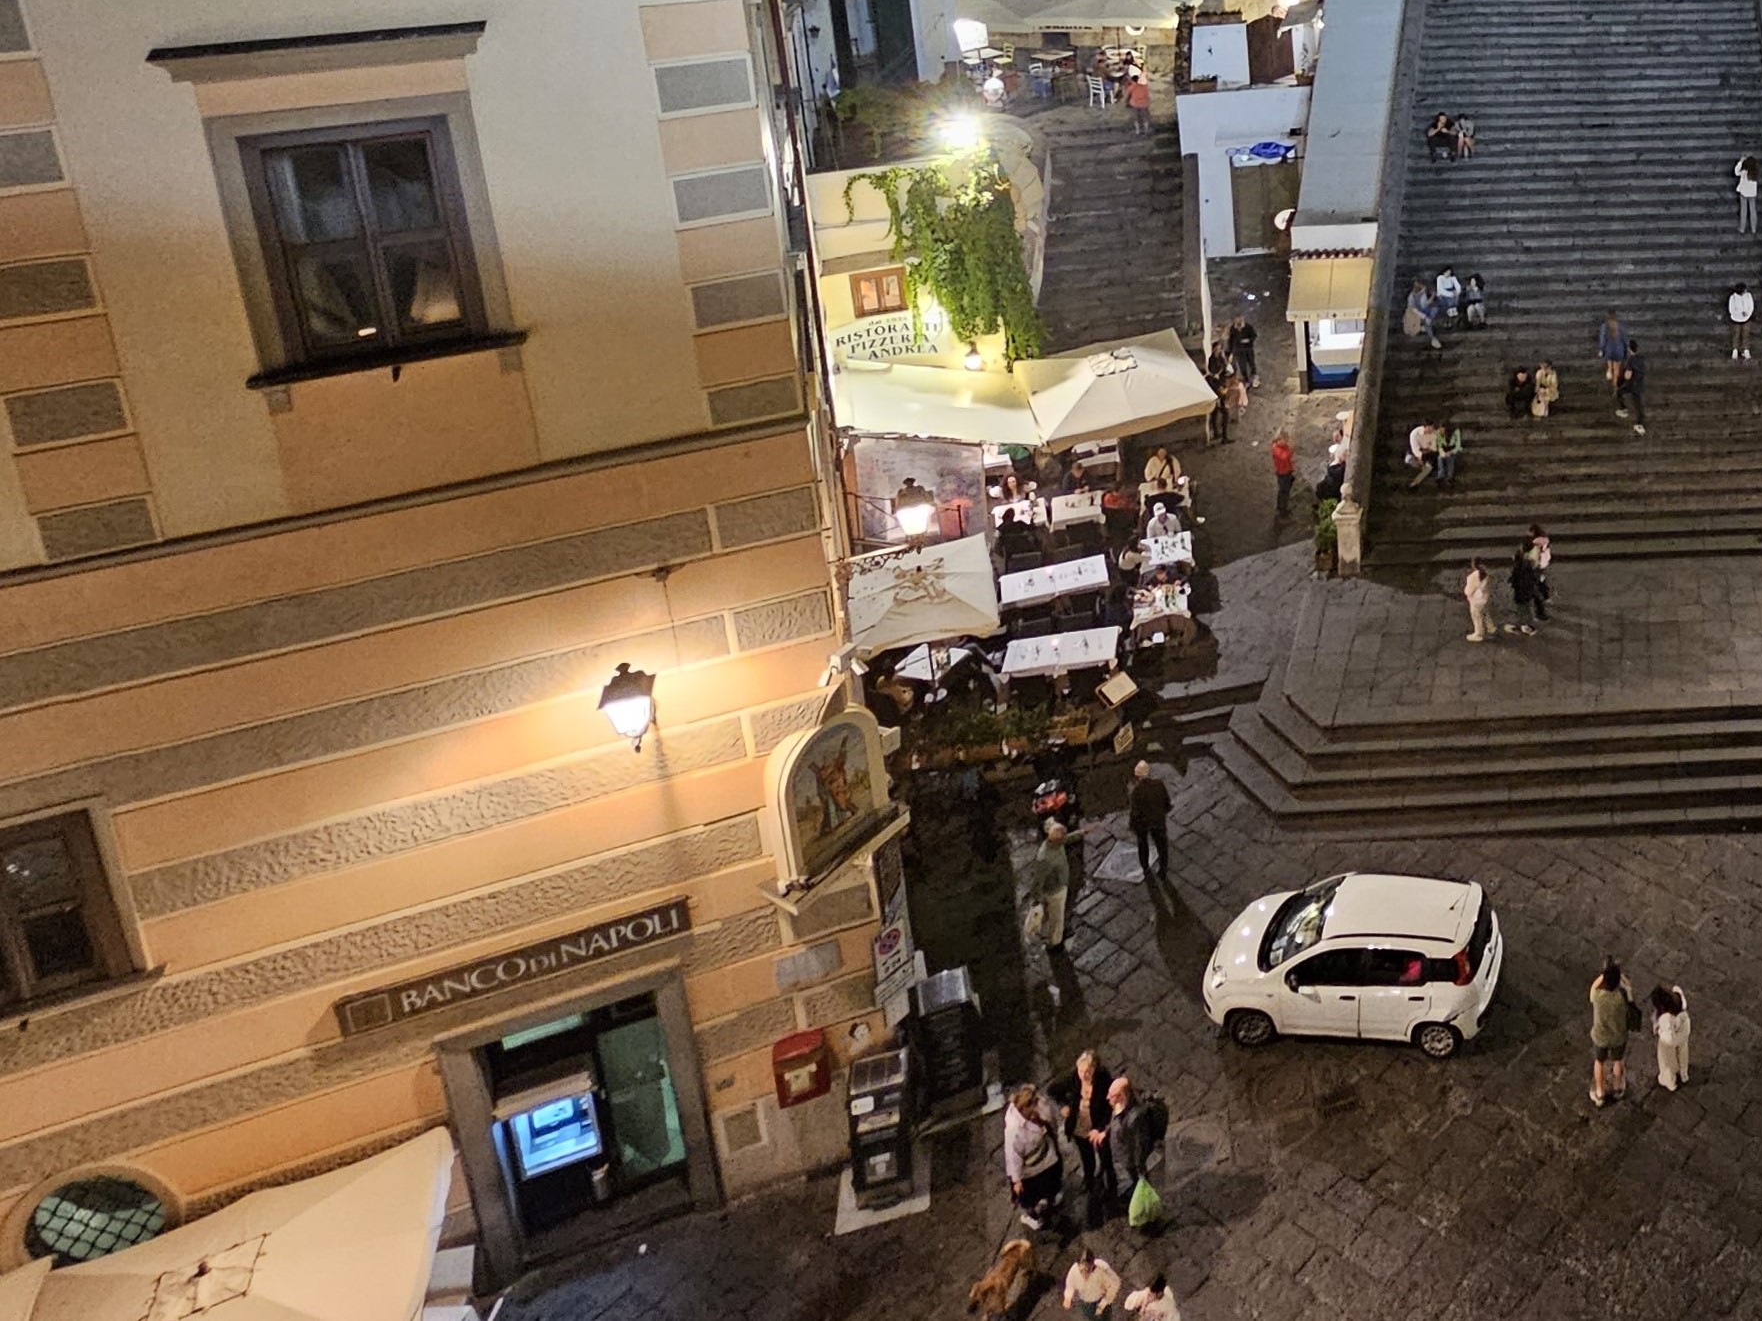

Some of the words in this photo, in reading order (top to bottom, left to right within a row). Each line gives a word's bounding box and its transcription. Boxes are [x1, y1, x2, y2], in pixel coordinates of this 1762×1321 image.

[836, 322, 940, 348] RISTORAT
[850, 333, 931, 354] PIZZERA
[868, 344, 939, 360] ANDREA
[400, 957, 527, 1013] BANCO
[529, 951, 557, 973] DI
[560, 908, 679, 964] NAPOLI
